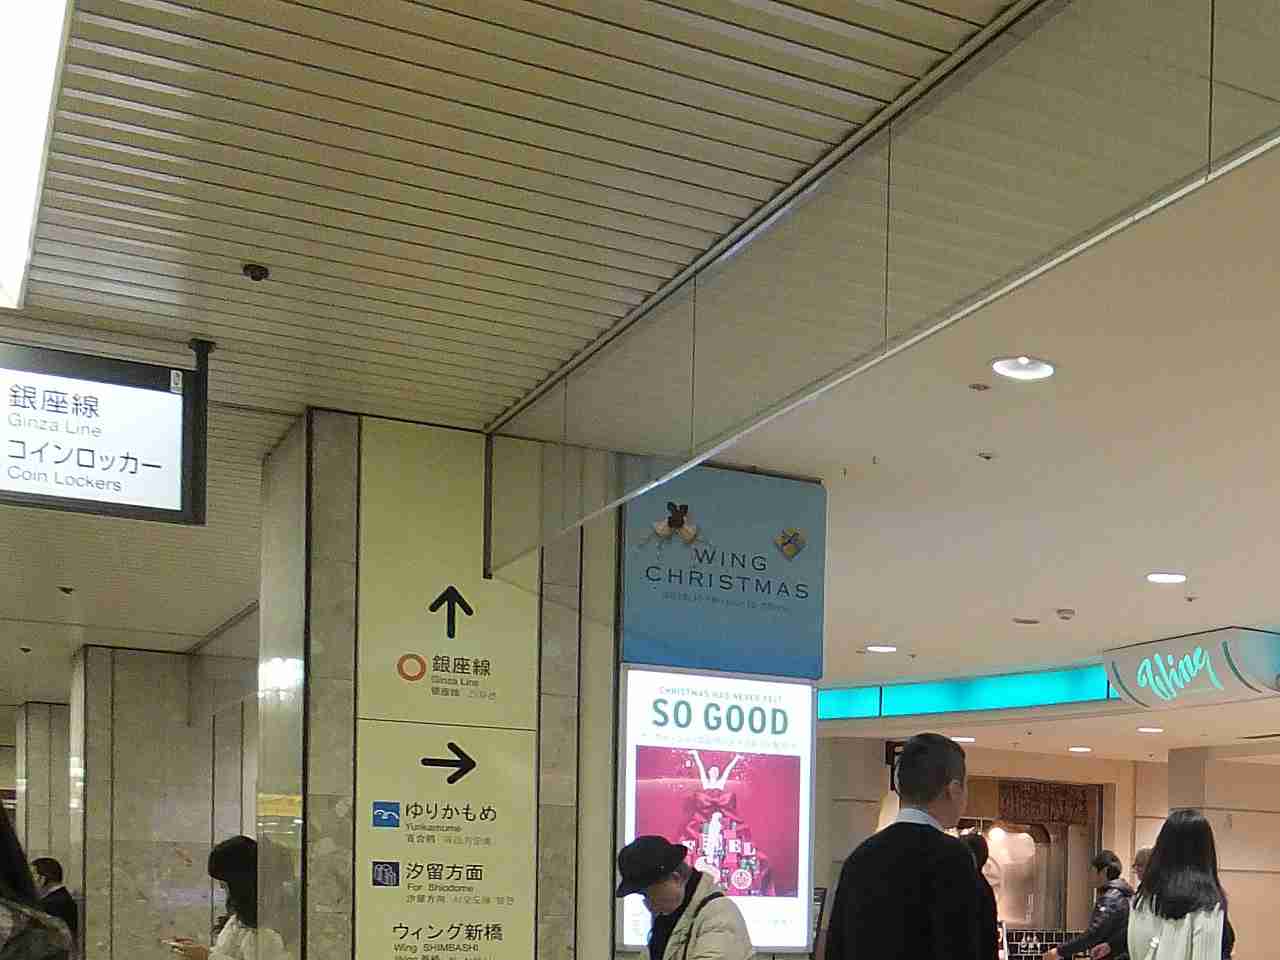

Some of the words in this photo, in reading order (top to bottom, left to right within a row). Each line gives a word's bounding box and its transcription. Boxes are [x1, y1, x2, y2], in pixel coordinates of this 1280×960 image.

[9, 384, 100, 418] 銀座線
[8, 413, 59, 432] Ginza
[65, 421, 102, 437] Line
[8, 439, 162, 474] コインロッカー
[8, 465, 48, 482] Coin
[54, 471, 122, 491] Lockers
[692, 547, 768, 571] WING
[646, 566, 809, 599] CHRISTMAS
[432, 655, 491, 676] 銀座線
[1136, 646, 1224, 701] Wing
[652, 698, 692, 728] SO
[703, 703, 789, 735] GOOD
[405, 801, 497, 821] ゆりかもめ
[405, 863, 484, 881] 汐留方面
[428, 883, 473, 892] Shiodome
[392, 922, 503, 941] ウィング新橋
[394, 943, 418, 953] Wing
[424, 943, 479, 952] SHIMBASHI
